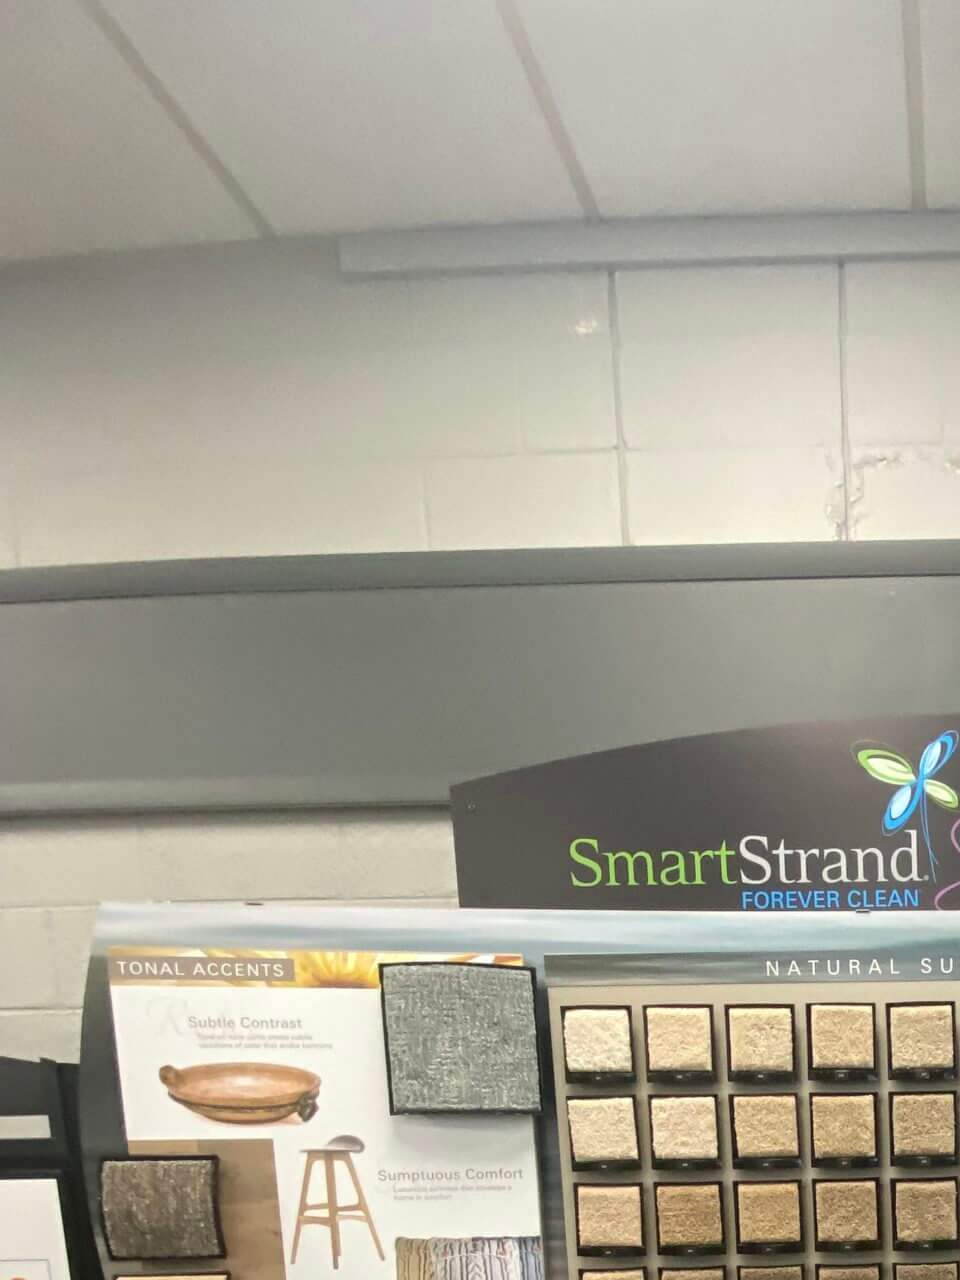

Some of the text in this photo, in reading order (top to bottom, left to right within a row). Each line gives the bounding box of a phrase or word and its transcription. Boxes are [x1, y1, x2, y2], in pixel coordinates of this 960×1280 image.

[568, 829, 929, 888] SmartStrand
[741, 888, 920, 910] FOREVER CLEAN
[117, 960, 285, 978] TONAL ACCENTS
[765, 958, 901, 977] NATURAL
[187, 1015, 303, 1030] Subtle Contrast
[377, 1168, 524, 1184] Sumptuous Comfort
